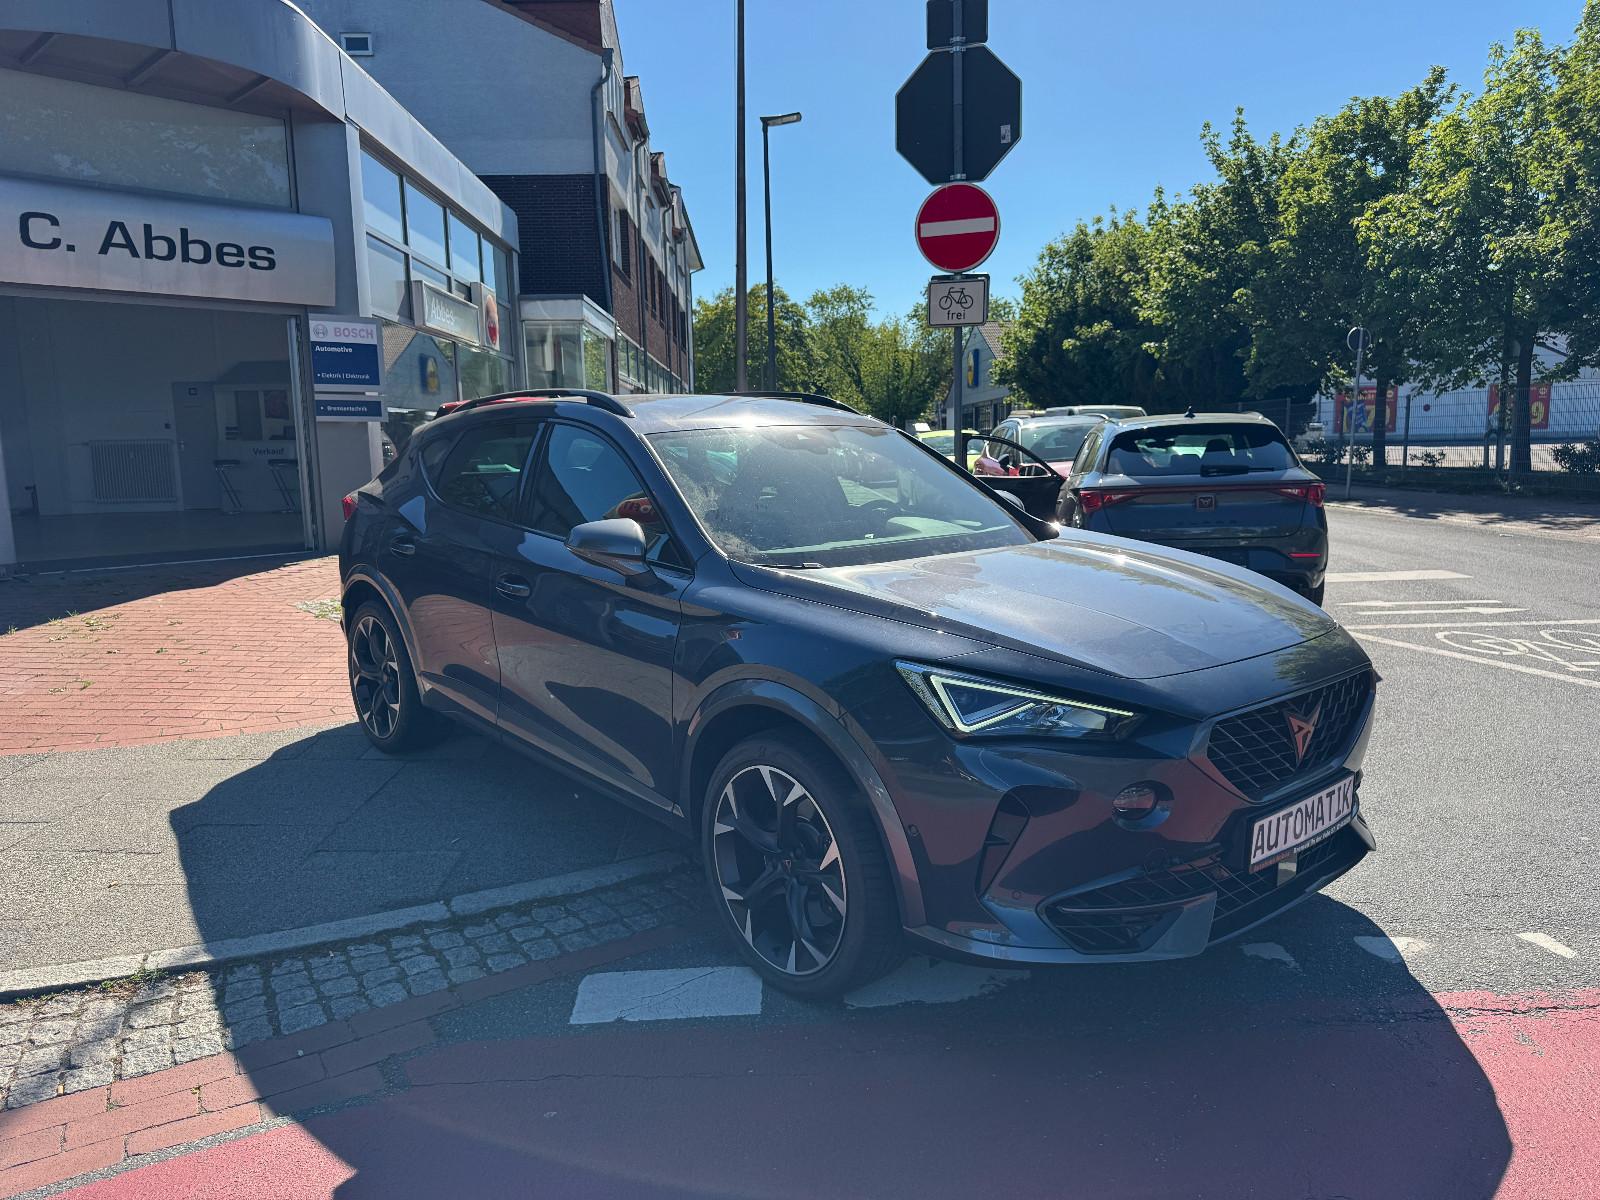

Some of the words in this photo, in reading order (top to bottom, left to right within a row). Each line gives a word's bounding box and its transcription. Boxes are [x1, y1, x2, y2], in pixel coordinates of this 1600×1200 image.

[19, 211, 76, 253] C.
[98, 220, 277, 271] Abbes
[947, 309, 966, 321] frei
[333, 327, 374, 340] BOSCH
[315, 345, 353, 353] Automotive
[252, 447, 285, 457] Verkauf
[1253, 780, 1353, 859] AUTOMATIK
